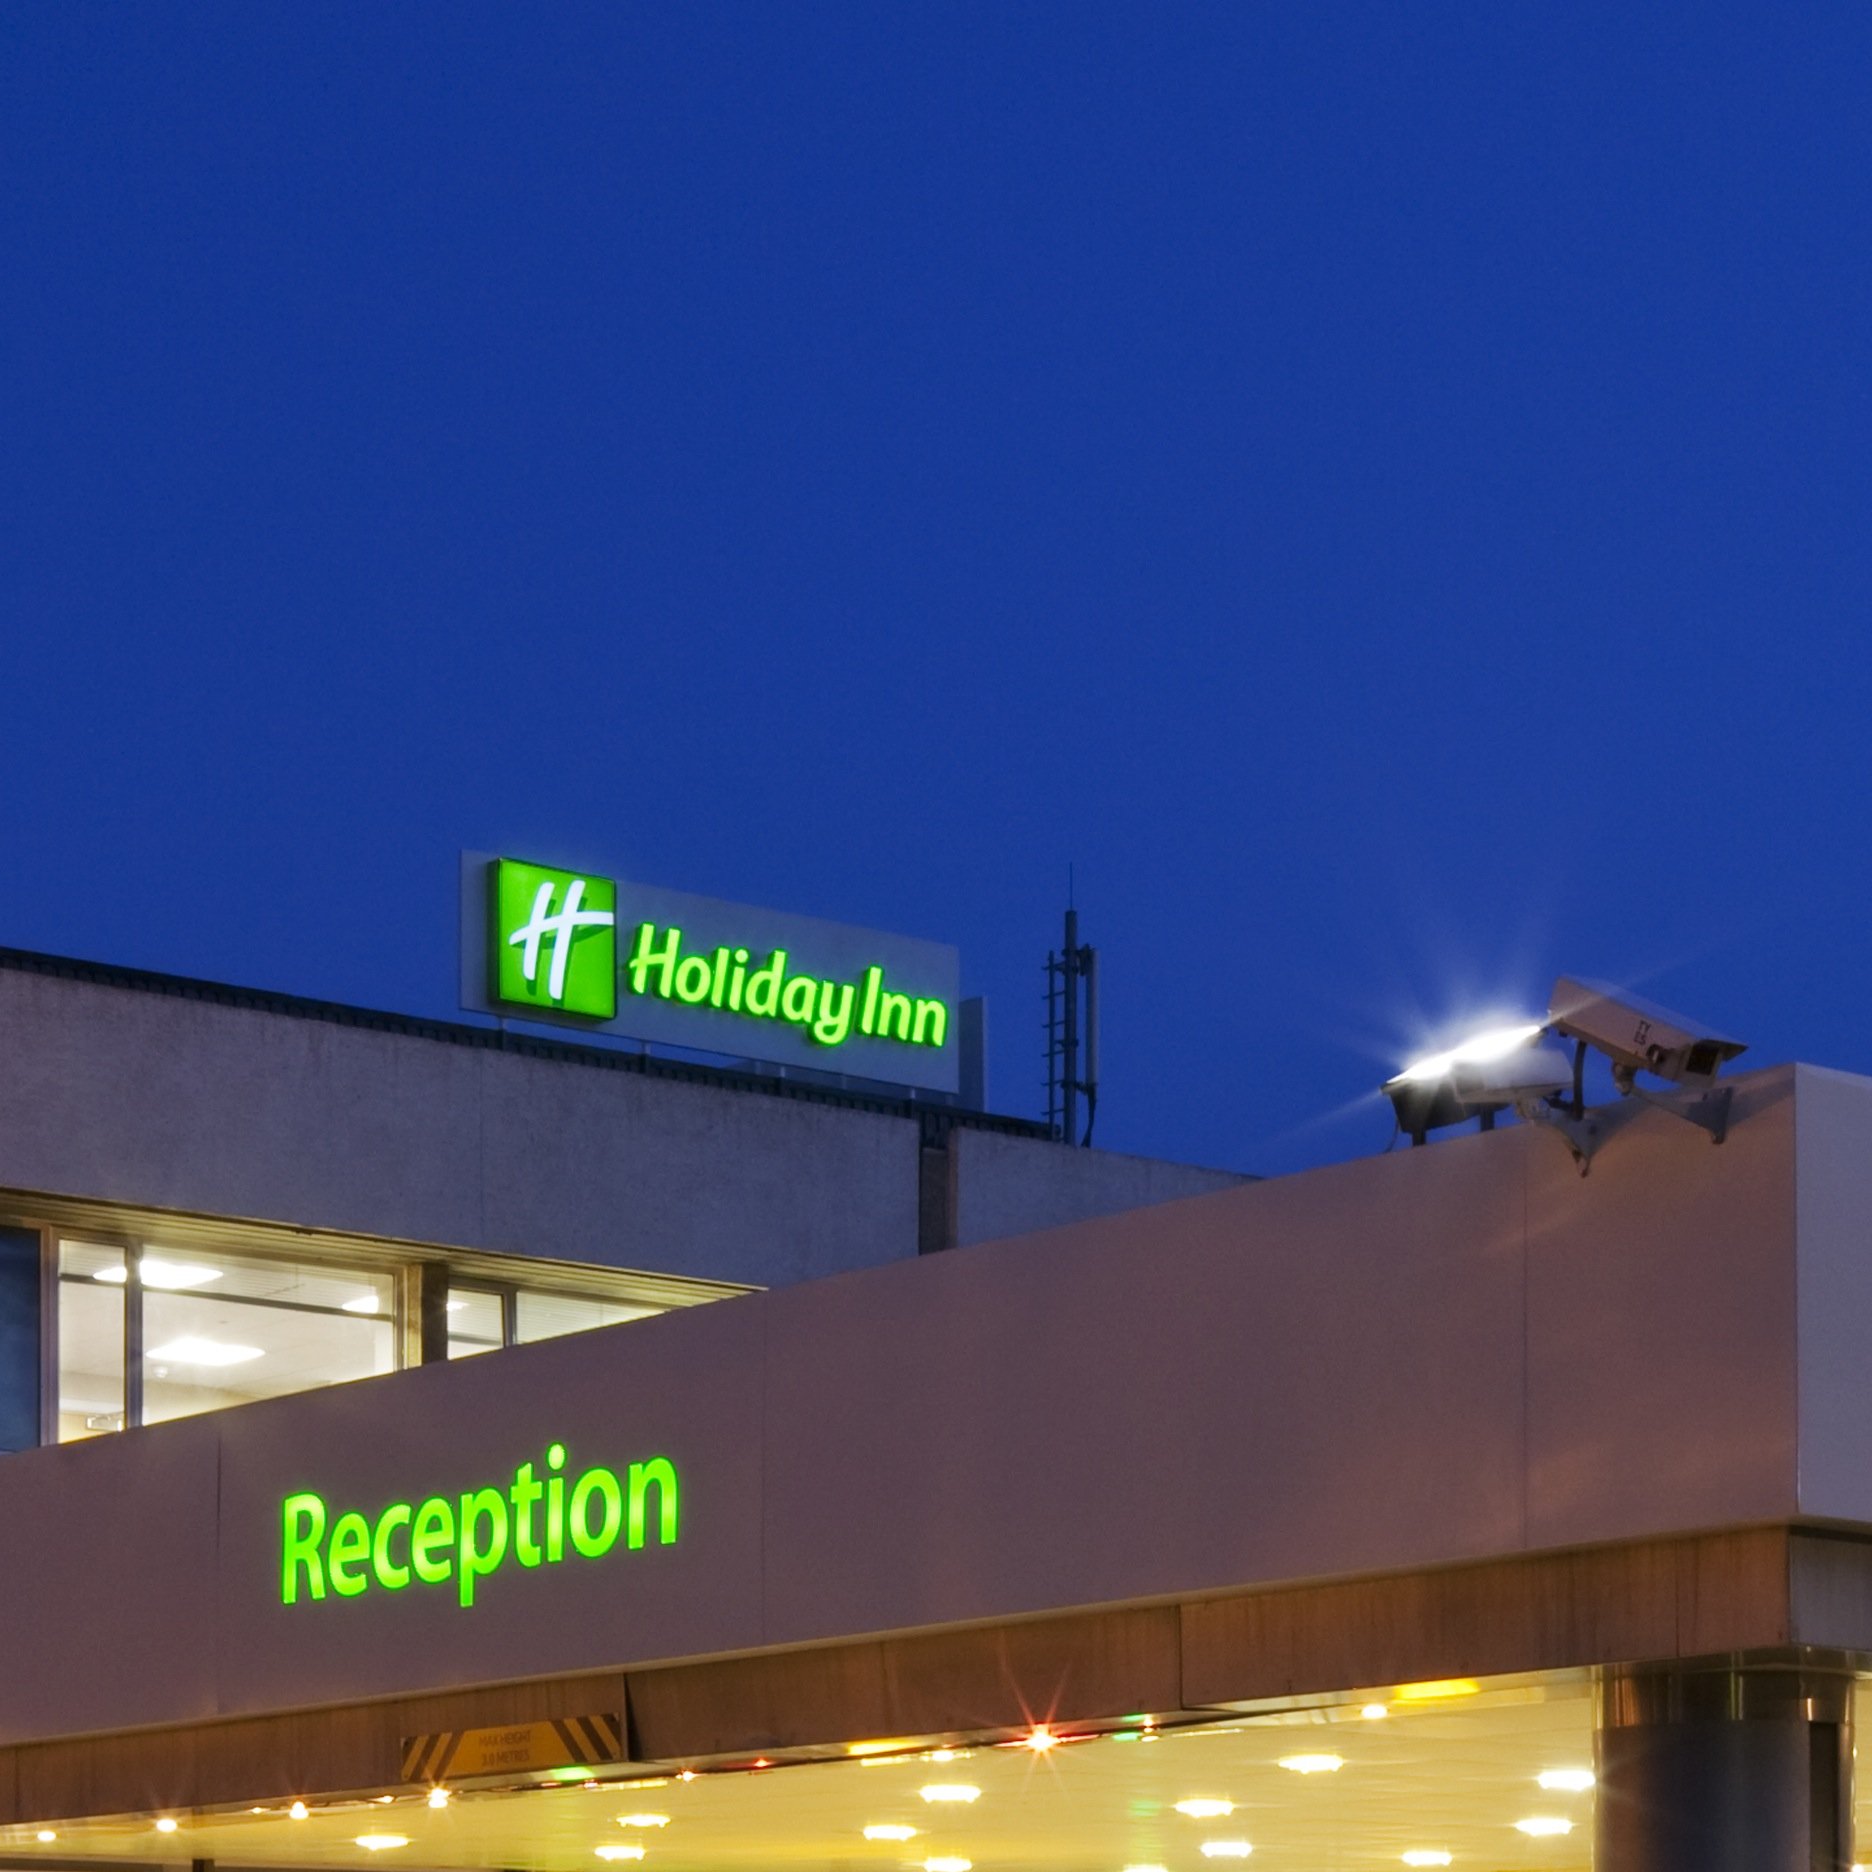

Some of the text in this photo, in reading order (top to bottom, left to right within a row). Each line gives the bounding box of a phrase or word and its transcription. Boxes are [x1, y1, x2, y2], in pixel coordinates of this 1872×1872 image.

[508, 879, 615, 1000] H
[629, 922, 947, 1047] Holiday Inn
[282, 1442, 678, 1608] Reception
